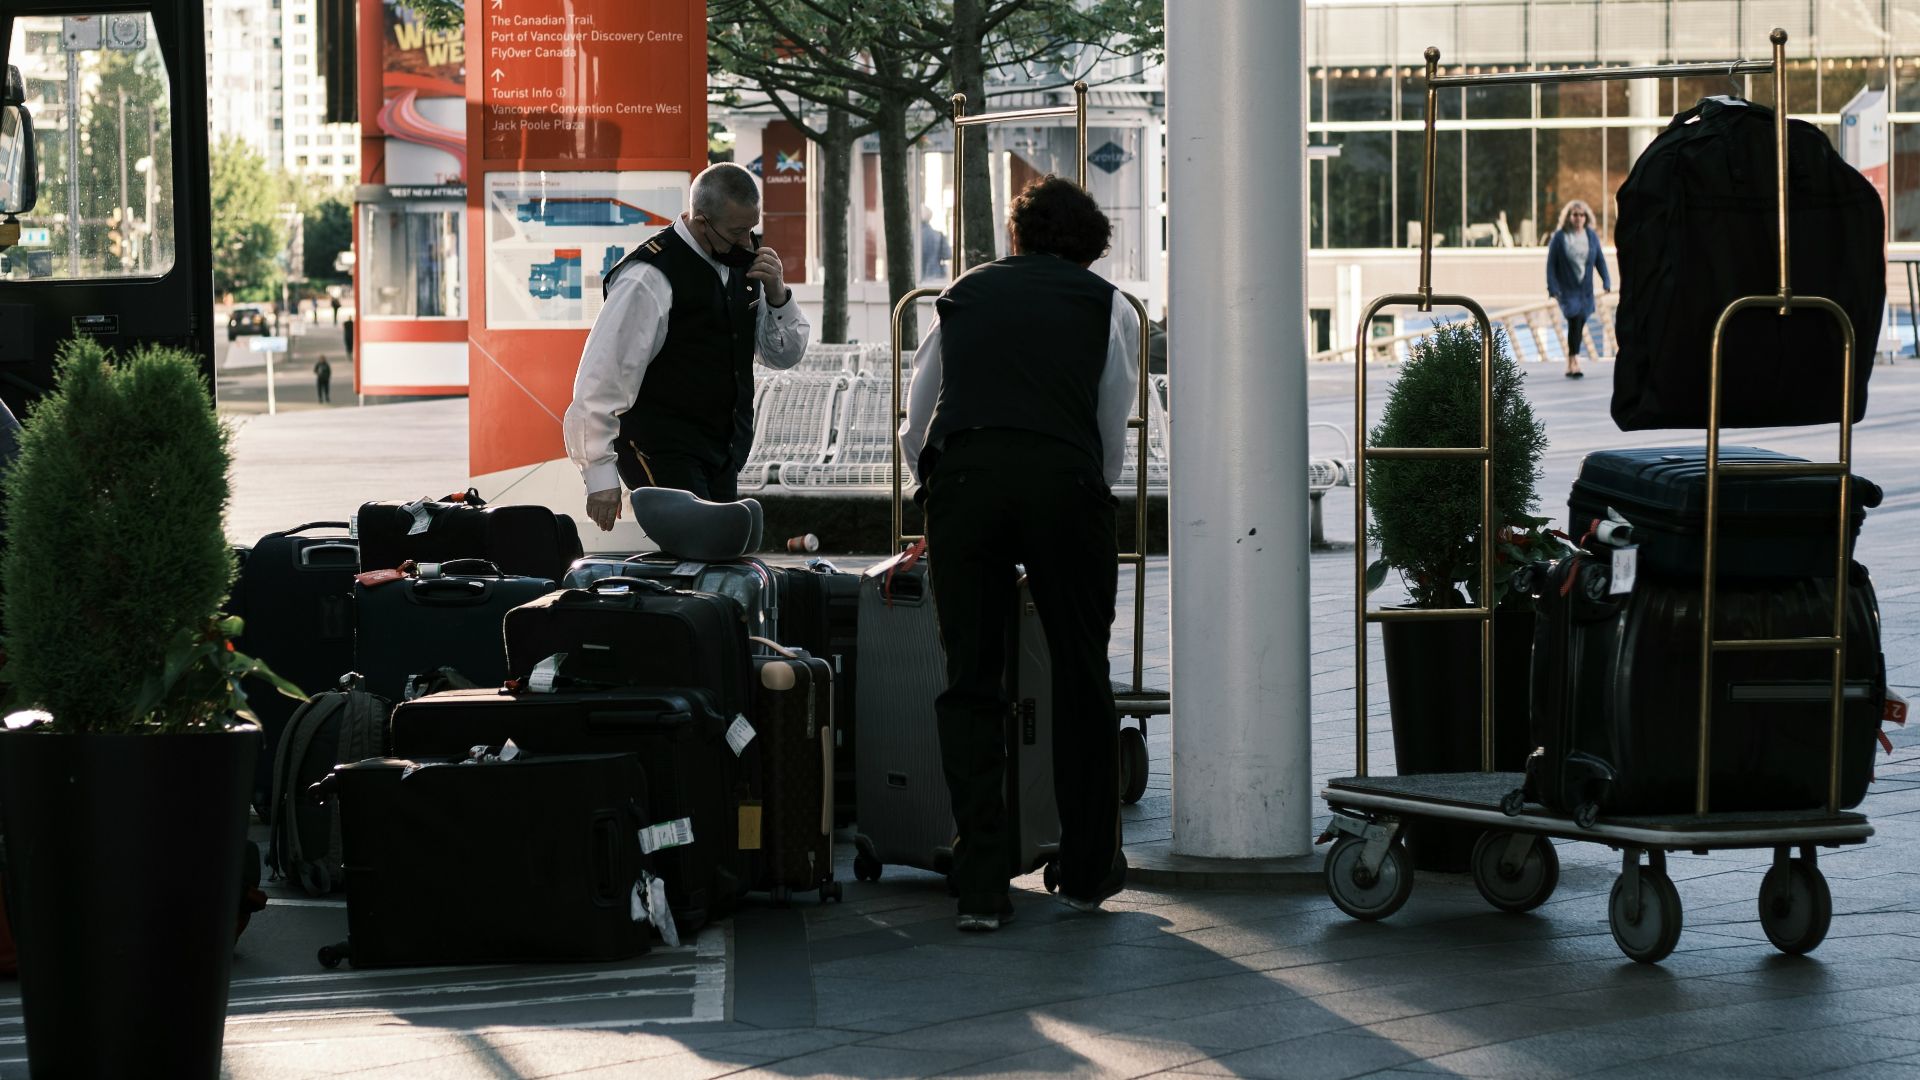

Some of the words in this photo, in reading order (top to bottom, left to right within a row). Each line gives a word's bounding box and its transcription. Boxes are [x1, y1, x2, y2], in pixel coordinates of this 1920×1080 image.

[491, 15, 511, 26] The
[514, 14, 565, 26] Canadian
[568, 14, 593, 25] Trail
[491, 31, 514, 42] Port
[517, 31, 528, 42] of
[530, 31, 587, 42] Vancouver
[591, 30, 644, 44] Discovery
[647, 30, 683, 42] Centre
[491, 47, 532, 60] FlyOver
[535, 46, 576, 58] Canada
[491, 87, 528, 99] Tourist
[532, 87, 553, 98] Info
[491, 103, 548, 115] Vancouver
[550, 103, 613, 114] Convention
[616, 102, 653, 114] Centre
[655, 102, 682, 114] West
[492, 120, 517, 131] Jack
[520, 119, 551, 131] Poole
[554, 119, 584, 130] Plaza
[766, 175, 792, 184] CANADA
